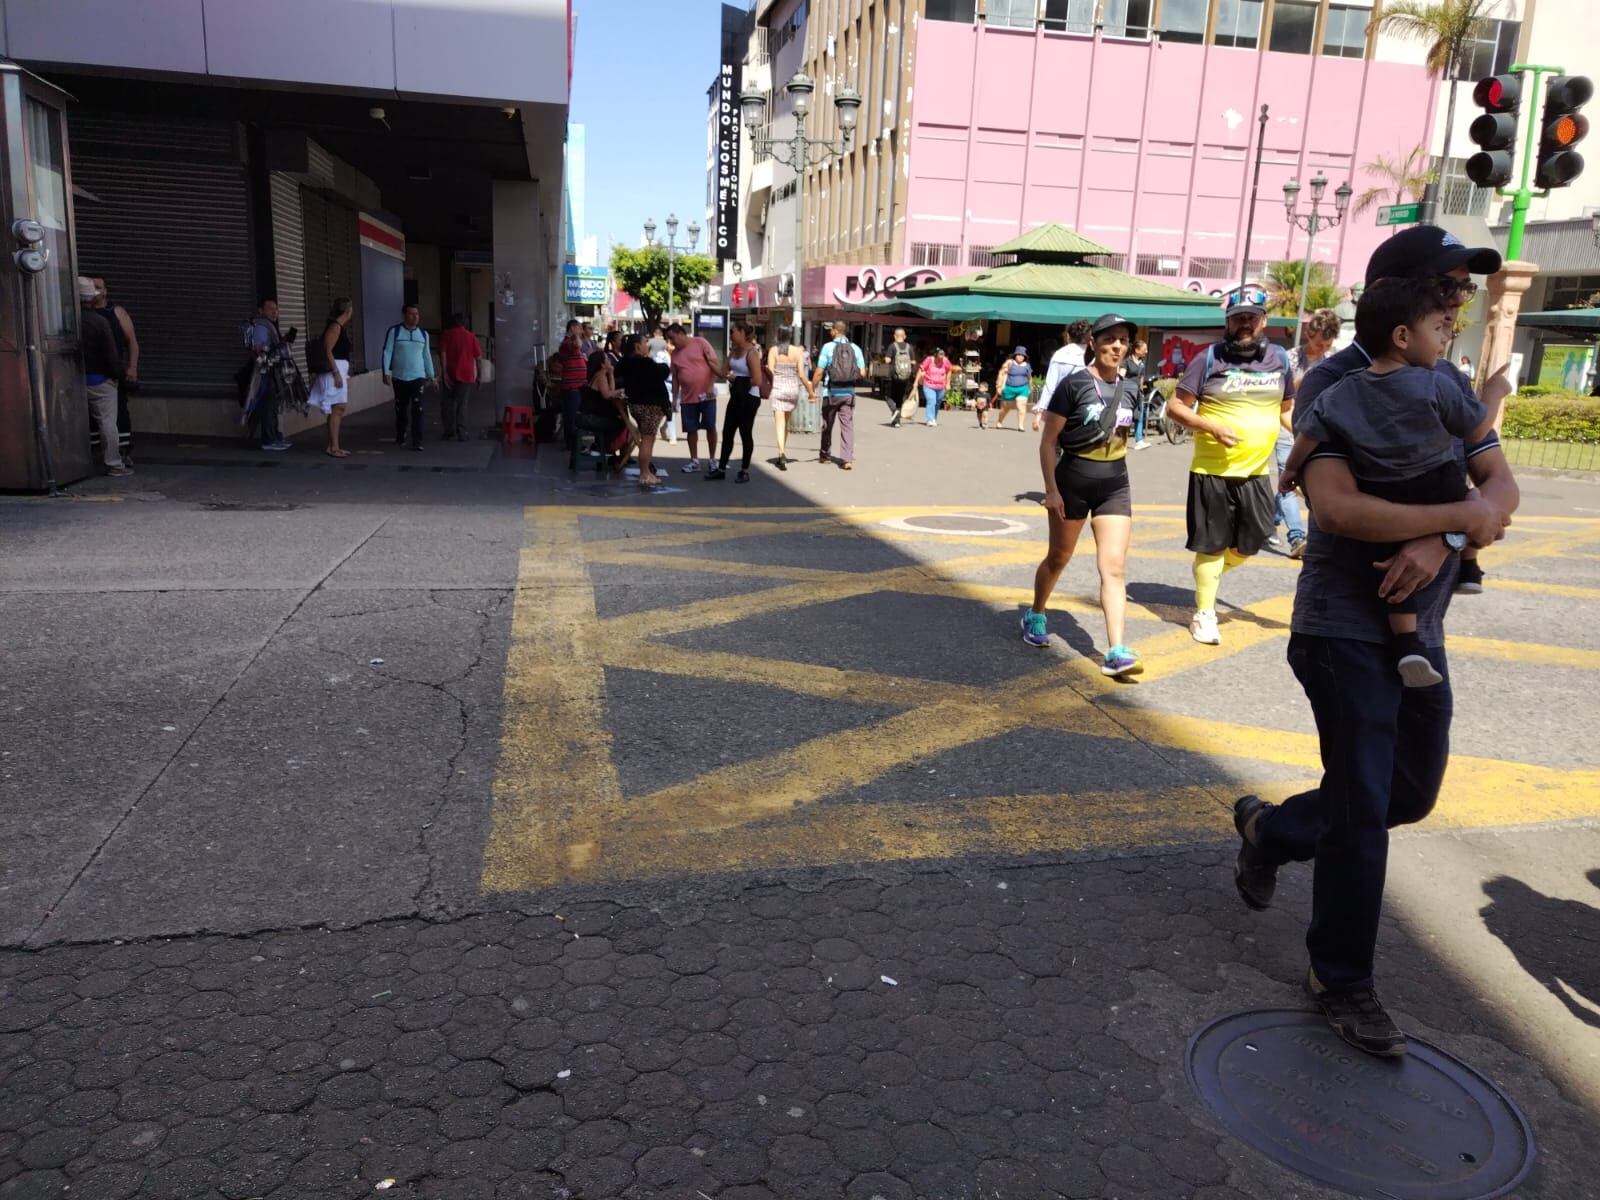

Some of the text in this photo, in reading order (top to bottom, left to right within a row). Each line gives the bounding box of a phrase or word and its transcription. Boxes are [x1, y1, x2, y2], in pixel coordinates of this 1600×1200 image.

[718, 64, 733, 248] MUNDO COSMÉTICO
[731, 108, 739, 208] PROFESSIONAL
[568, 279, 605, 290] MUNDO
